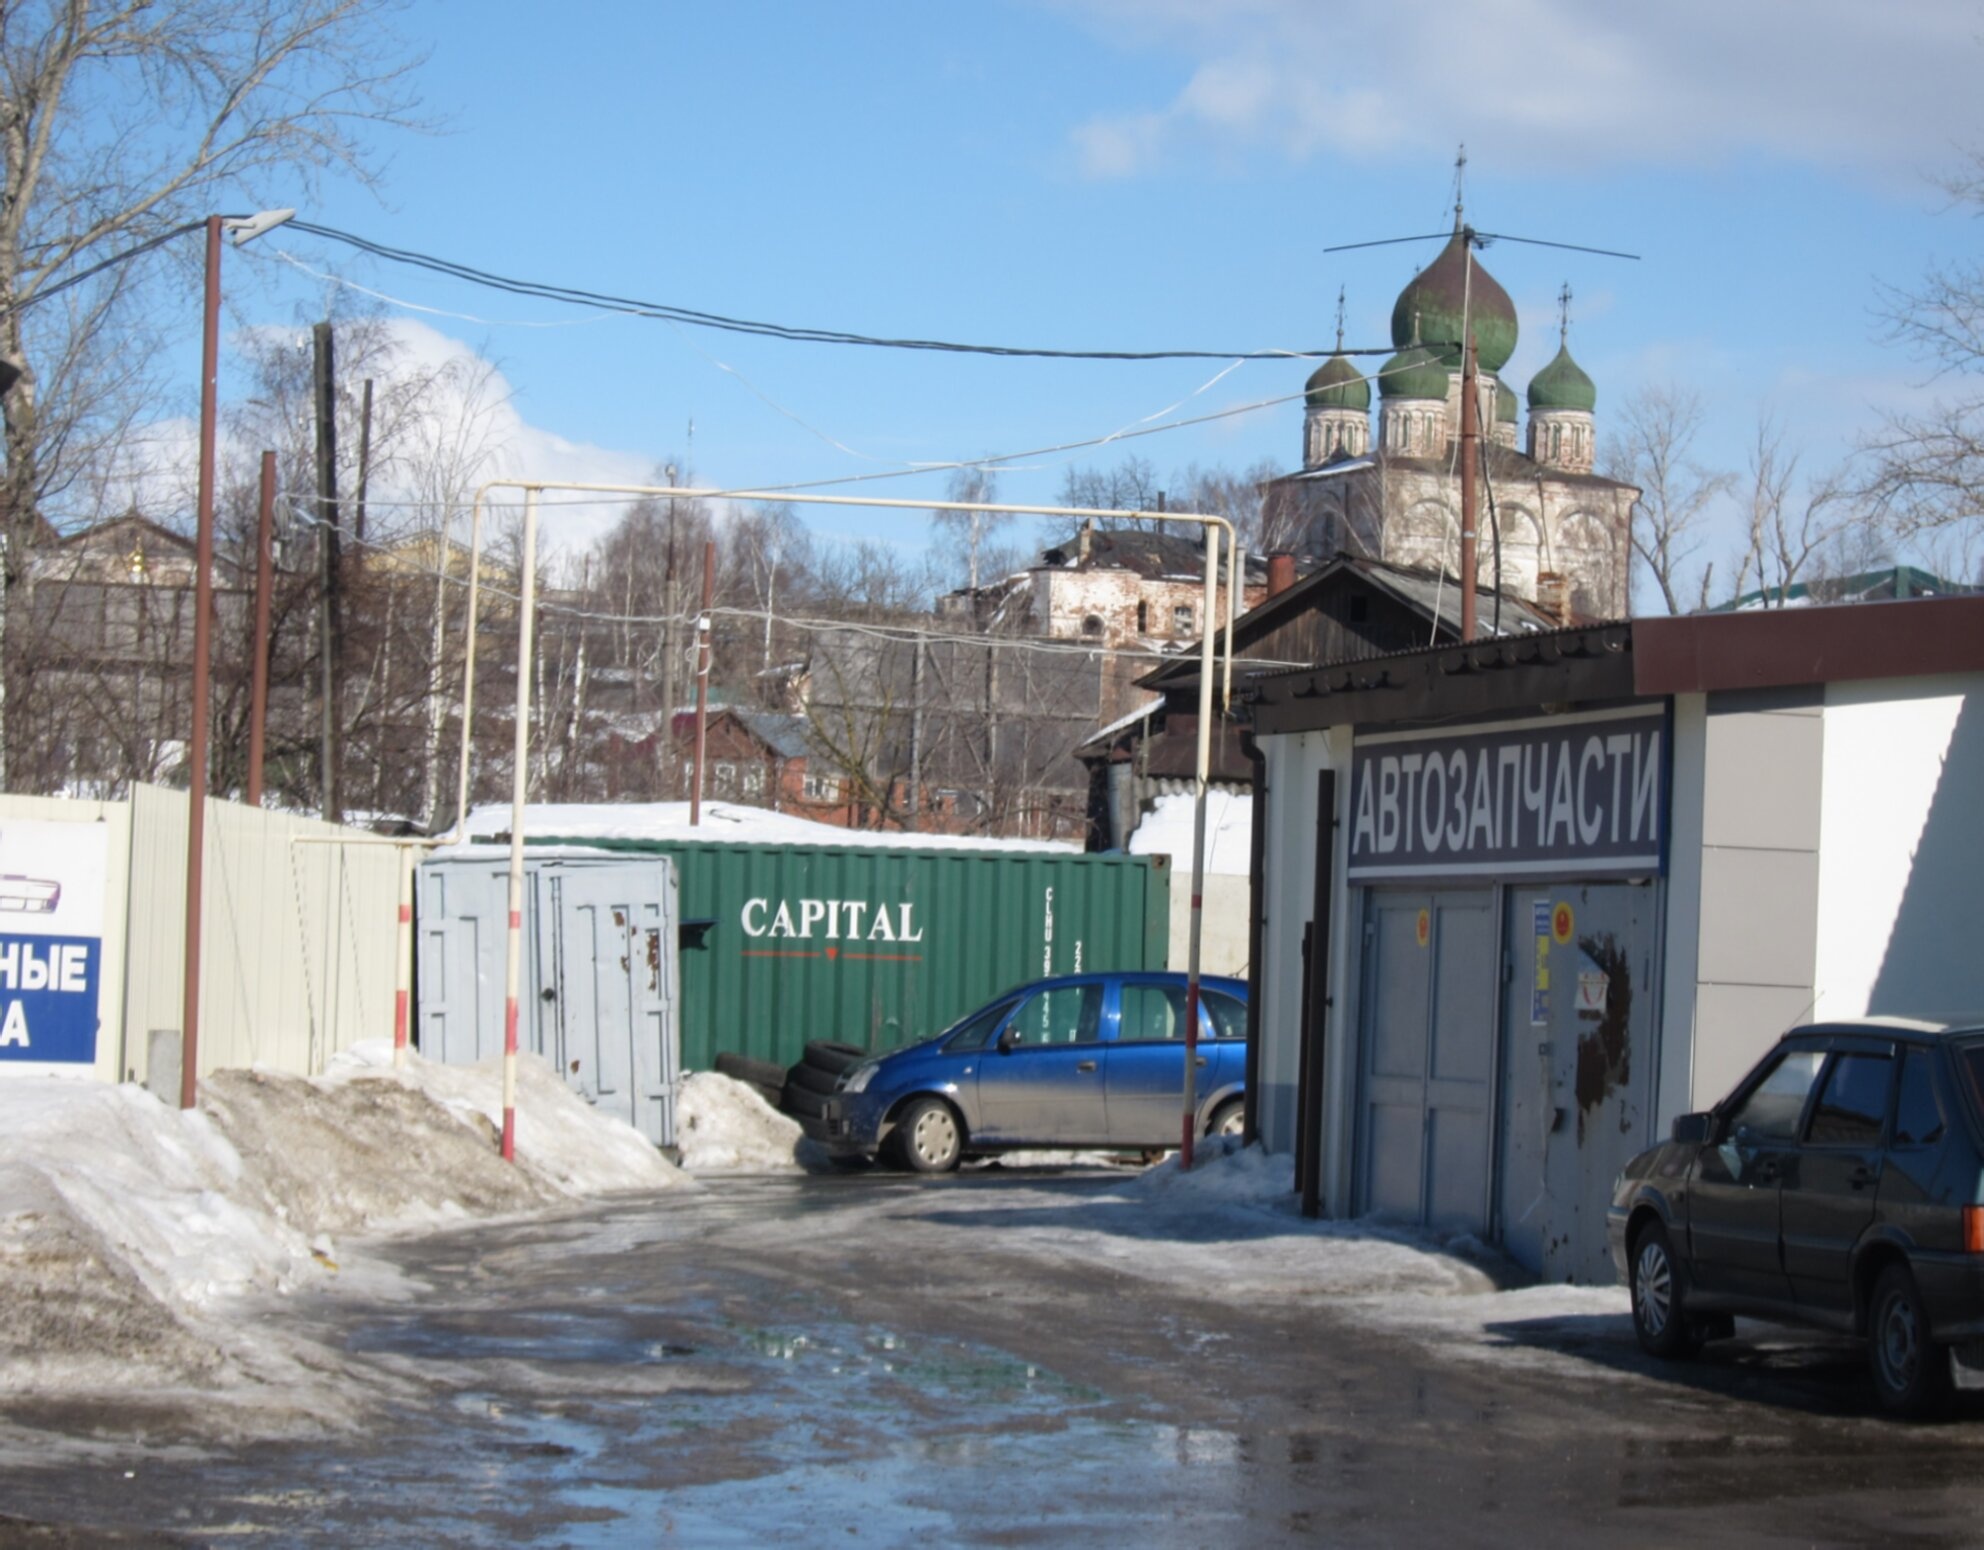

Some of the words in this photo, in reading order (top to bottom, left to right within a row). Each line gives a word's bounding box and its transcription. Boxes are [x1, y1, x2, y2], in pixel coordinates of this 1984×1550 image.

[1352, 731, 1660, 855] АВТОЗАПЧАСТИ
[740, 897, 924, 942] CAPITAL
[0, 999, 30, 1047] А
